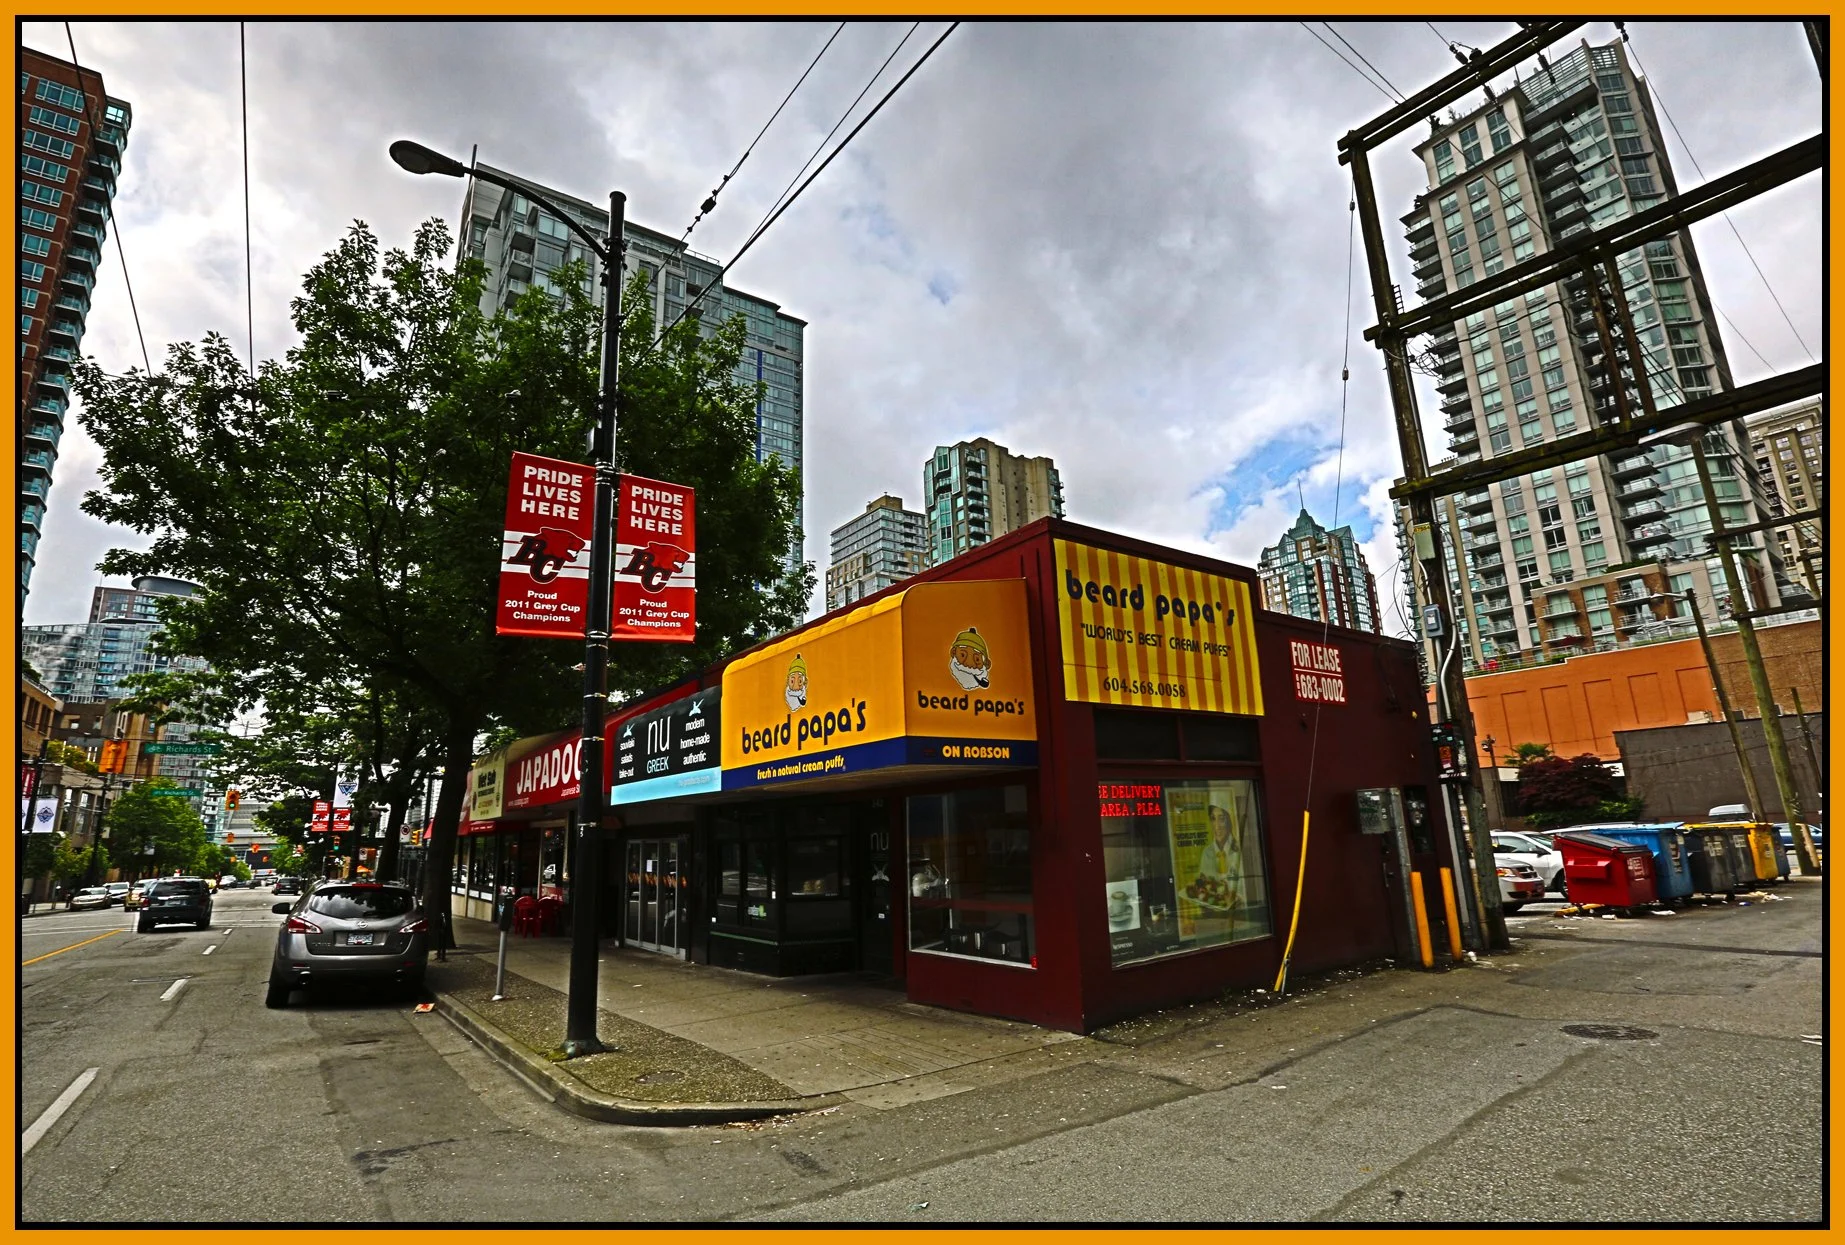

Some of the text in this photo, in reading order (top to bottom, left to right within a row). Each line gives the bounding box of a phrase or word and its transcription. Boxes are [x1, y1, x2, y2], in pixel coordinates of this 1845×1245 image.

[524, 466, 582, 487] PRIDE
[522, 482, 582, 504] LIVES
[631, 486, 684, 506] PRIDE
[520, 500, 580, 520] HERE
[631, 500, 683, 520] LIVES
[630, 516, 683, 536] HERE
[527, 590, 558, 600] Proud
[640, 599, 667, 608] Proud
[1065, 569, 1234, 627] beard papa's
[505, 600, 580, 613] 2011 Grey Cup
[620, 608, 690, 618] 2011 Grey Cup
[513, 612, 571, 622] Champions
[627, 618, 681, 628] Champions
[1138, 634, 1162, 648] BEST
[1169, 637, 1200, 652] CREAM
[1291, 642, 1341, 672] FOR LEASE
[1104, 677, 1186, 698] 604.568.0058
[1300, 674, 1345, 702] 683-0002
[918, 690, 1024, 717] beard papa's
[686, 718, 704, 731] modern
[742, 698, 866, 754] beard papa's
[648, 716, 671, 755] nu
[680, 732, 710, 749] home-made
[683, 750, 707, 765] authentic
[942, 746, 1009, 759] ON ROBSON
[647, 756, 669, 773] GREEK
[778, 762, 801, 776] natural
[802, 759, 823, 773] cream
[1110, 786, 1160, 798] DELIVERY
[870, 832, 889, 851] nu
